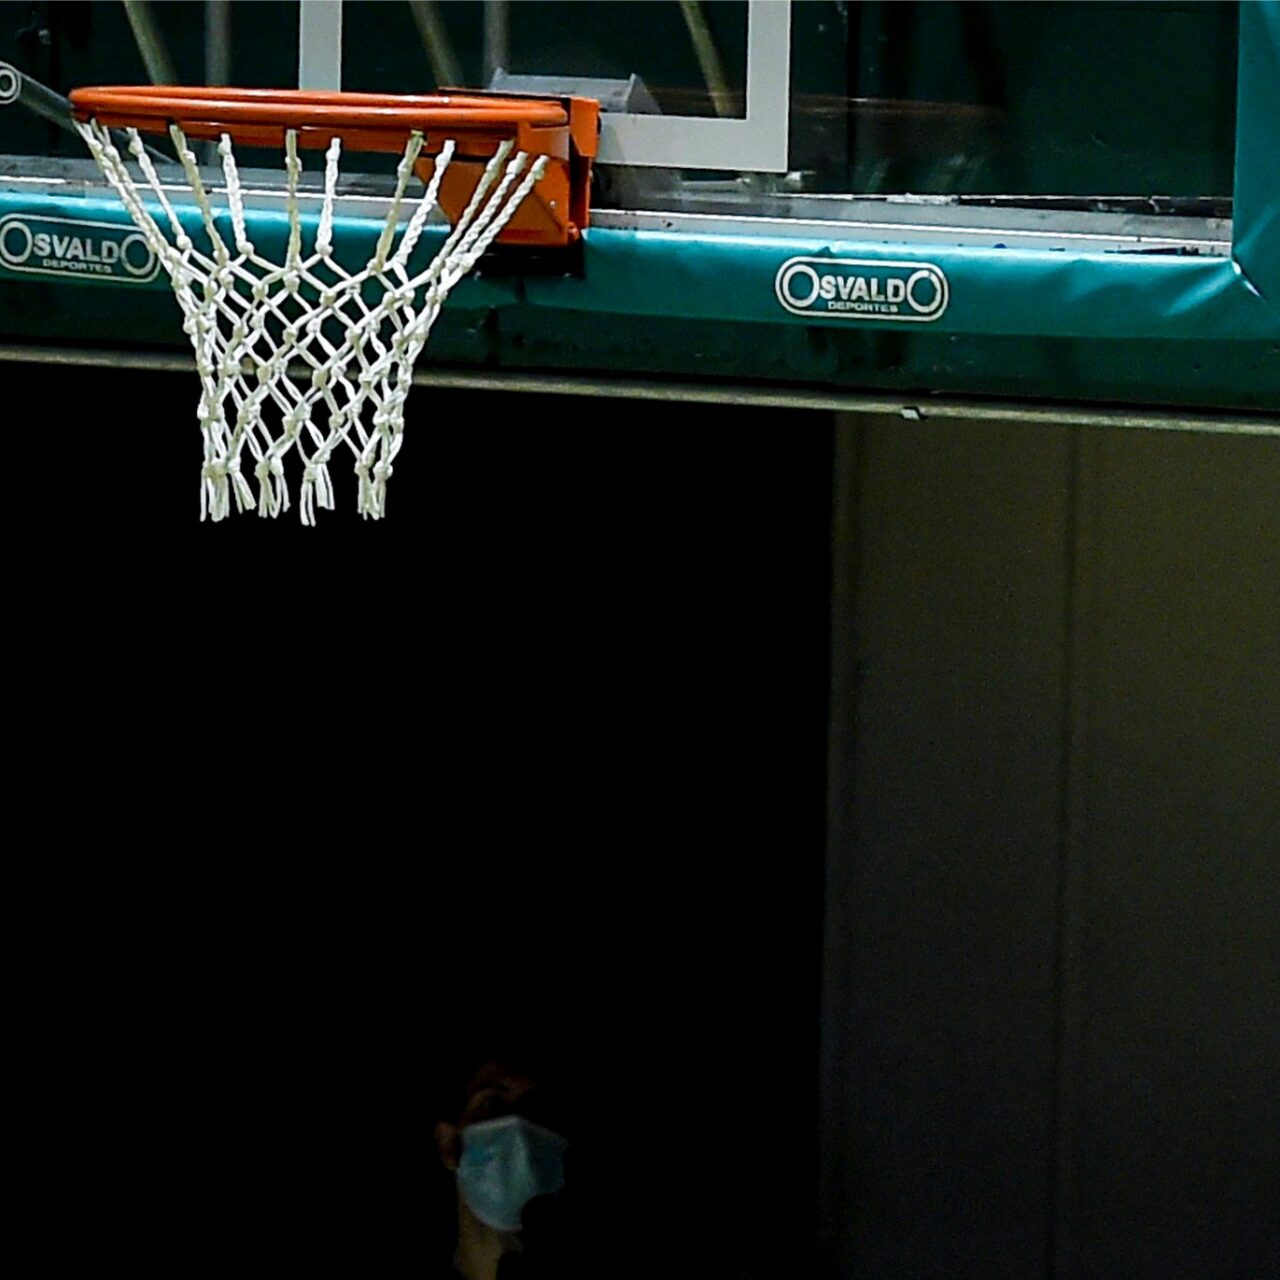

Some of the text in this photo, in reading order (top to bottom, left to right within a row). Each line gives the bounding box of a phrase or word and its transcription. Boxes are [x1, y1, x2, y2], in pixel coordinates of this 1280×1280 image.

[0, 221, 155, 276] OSVALDO
[42, 258, 113, 274] DEPORTES
[783, 264, 943, 314] OSVALDO
[827, 301, 899, 313] DEPORTES
